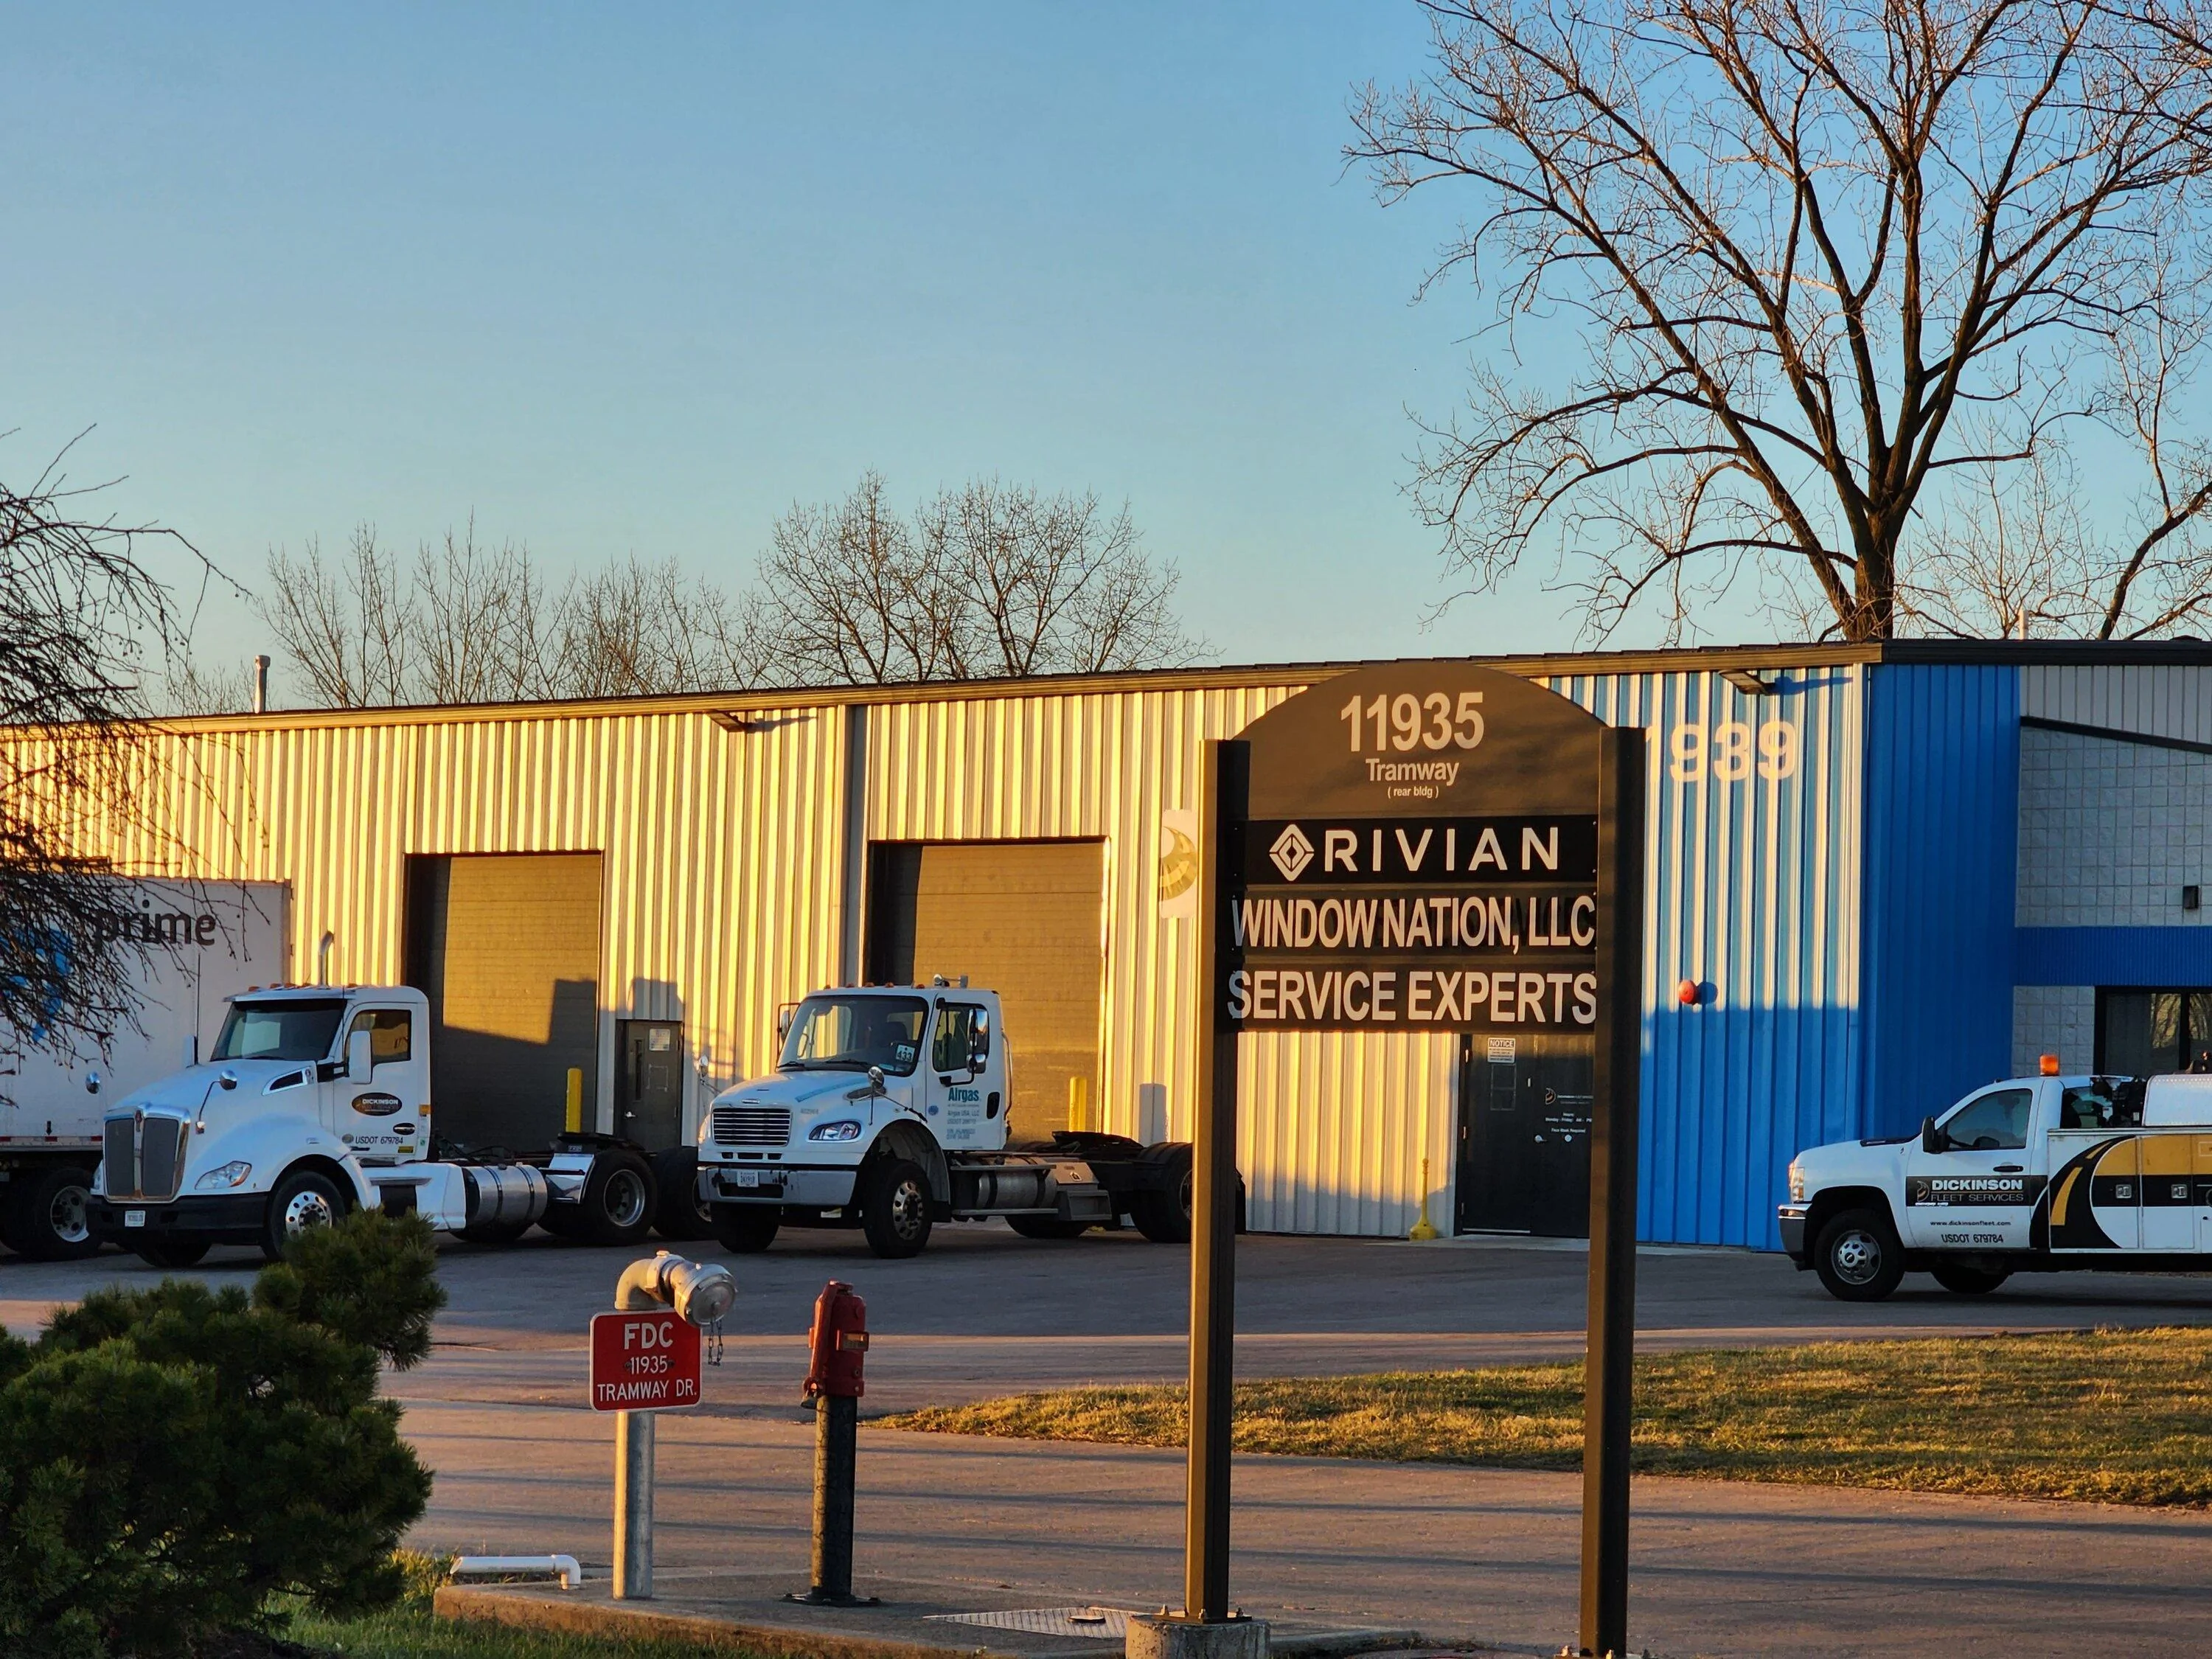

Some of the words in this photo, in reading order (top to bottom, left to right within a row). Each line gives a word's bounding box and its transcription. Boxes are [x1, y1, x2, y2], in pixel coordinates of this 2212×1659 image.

[1340, 691, 1485, 752] 11935
[1365, 758, 1460, 786] Tramway
[1324, 827, 1559, 872] RIVIAN
[95, 899, 216, 954] prime
[1231, 899, 1377, 948] WINDOW
[1382, 896, 1520, 955] NATION,
[1528, 895, 1596, 947] LLC
[1228, 970, 1397, 1022] SERVICE
[1408, 970, 1597, 1025] EXPERTS
[1489, 1039, 1514, 1047] NOTICE
[948, 1088, 979, 1102] Airgas
[355, 1136, 378, 1144] USDOT
[380, 1136, 403, 1144] 679784
[1932, 1179, 2023, 1191] DICKINSON
[1930, 1194, 1963, 1202] FLEET
[1969, 1193, 2024, 1202] SERVICES
[1941, 1234, 1969, 1243] USDOT
[1973, 1234, 2004, 1243] 679784
[624, 1321, 674, 1350] FDC
[630, 1355, 667, 1375] 11935
[597, 1380, 669, 1402] TRAMWAY
[676, 1378, 698, 1397] DR.
